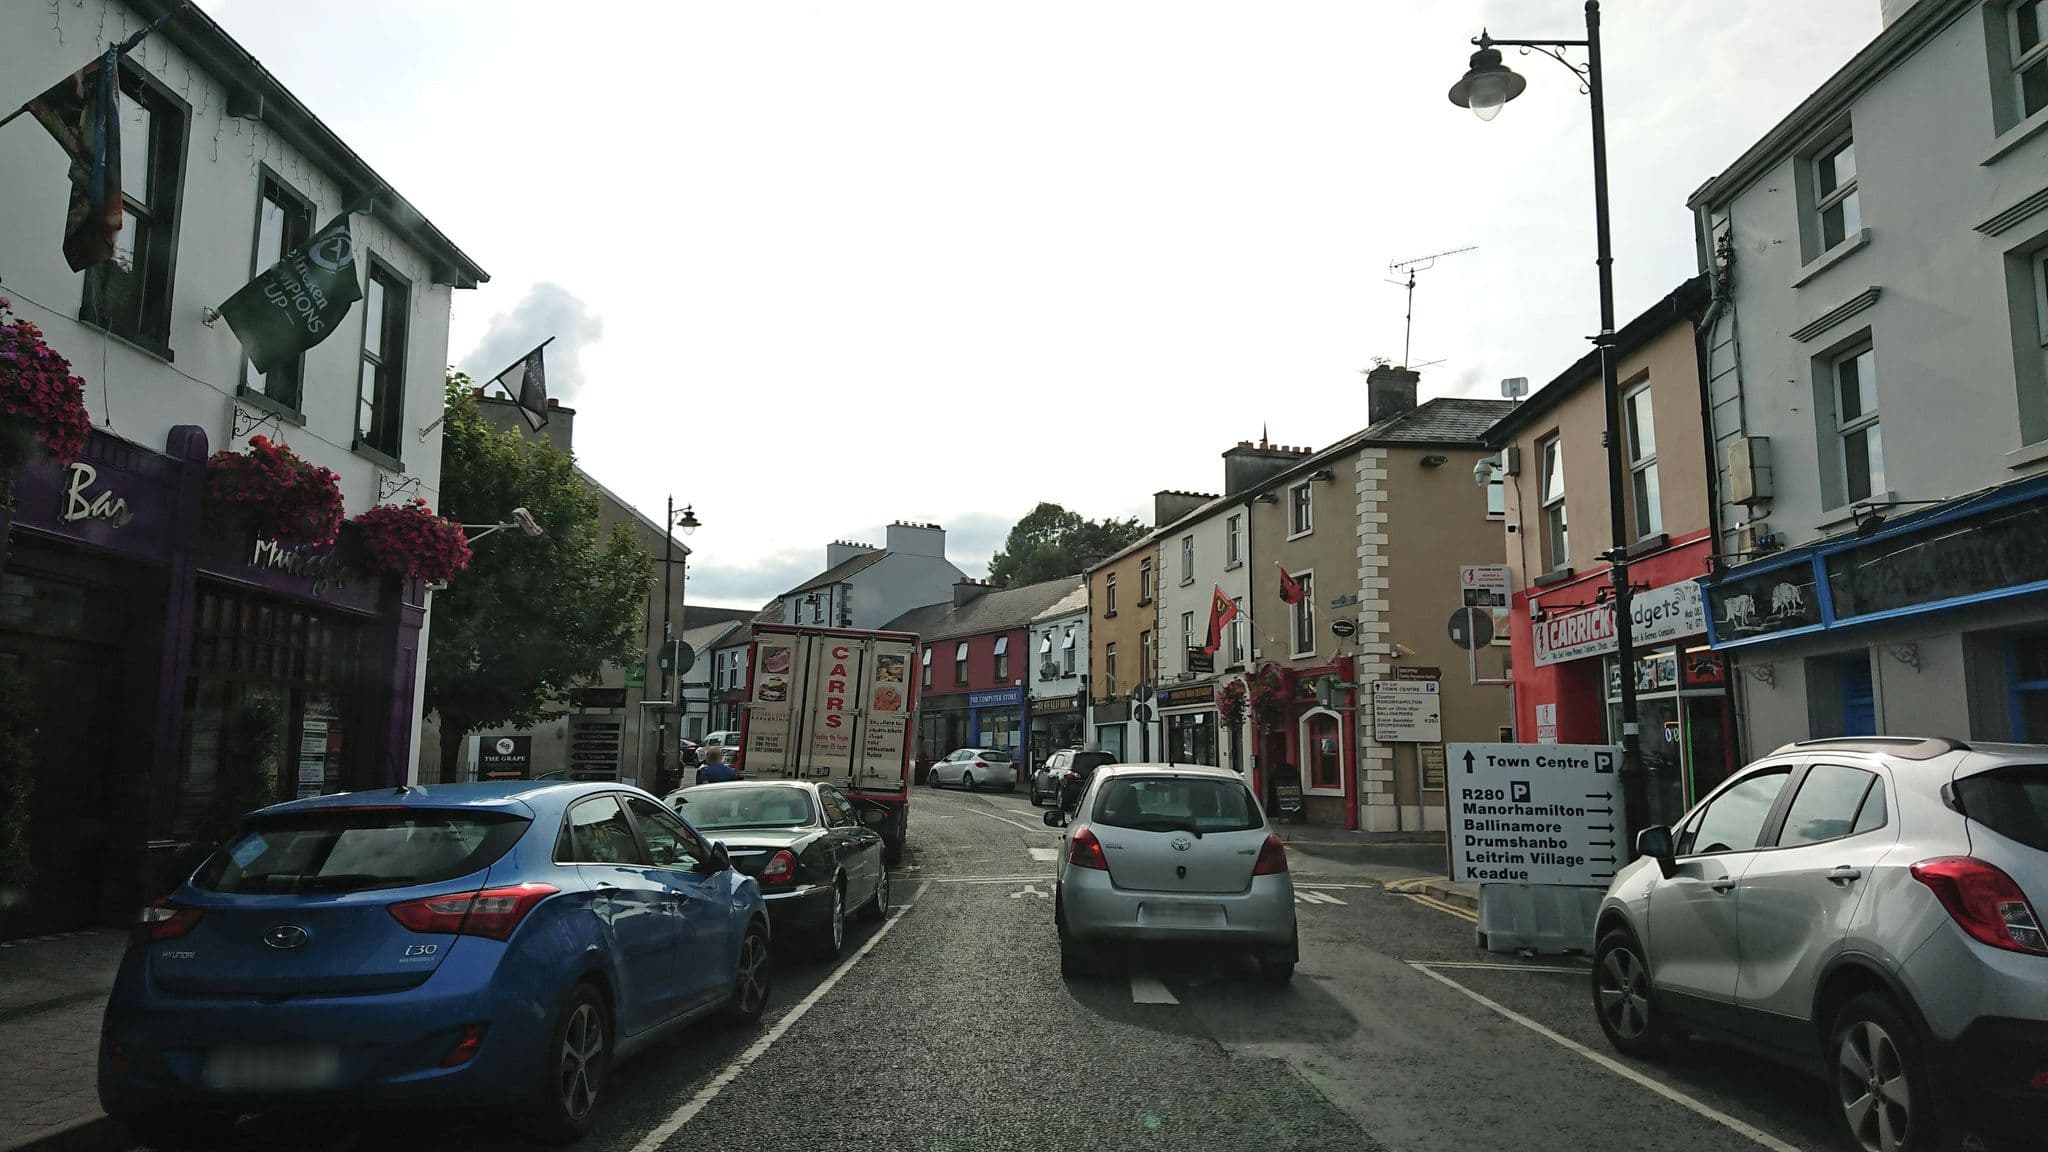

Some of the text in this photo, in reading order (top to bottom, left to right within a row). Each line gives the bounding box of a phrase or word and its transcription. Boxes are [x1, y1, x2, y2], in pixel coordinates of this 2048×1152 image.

[64, 461, 134, 529] Bar
[1551, 598, 1680, 649] CARRICK dgets
[826, 646, 849, 728] CARRS
[1002, 693, 1016, 701] STORE
[1486, 755, 1530, 767] Town
[1536, 756, 1589, 768] Centre
[1463, 789, 1504, 800] R280
[1463, 803, 1584, 816] Manorhamilton
[1464, 819, 1562, 832] Ballinamore
[1465, 835, 1568, 848] Drumshanbo
[1466, 851, 1584, 867] Leitrim Village
[1467, 867, 1528, 880] Keadue
[405, 944, 438, 956] i30
